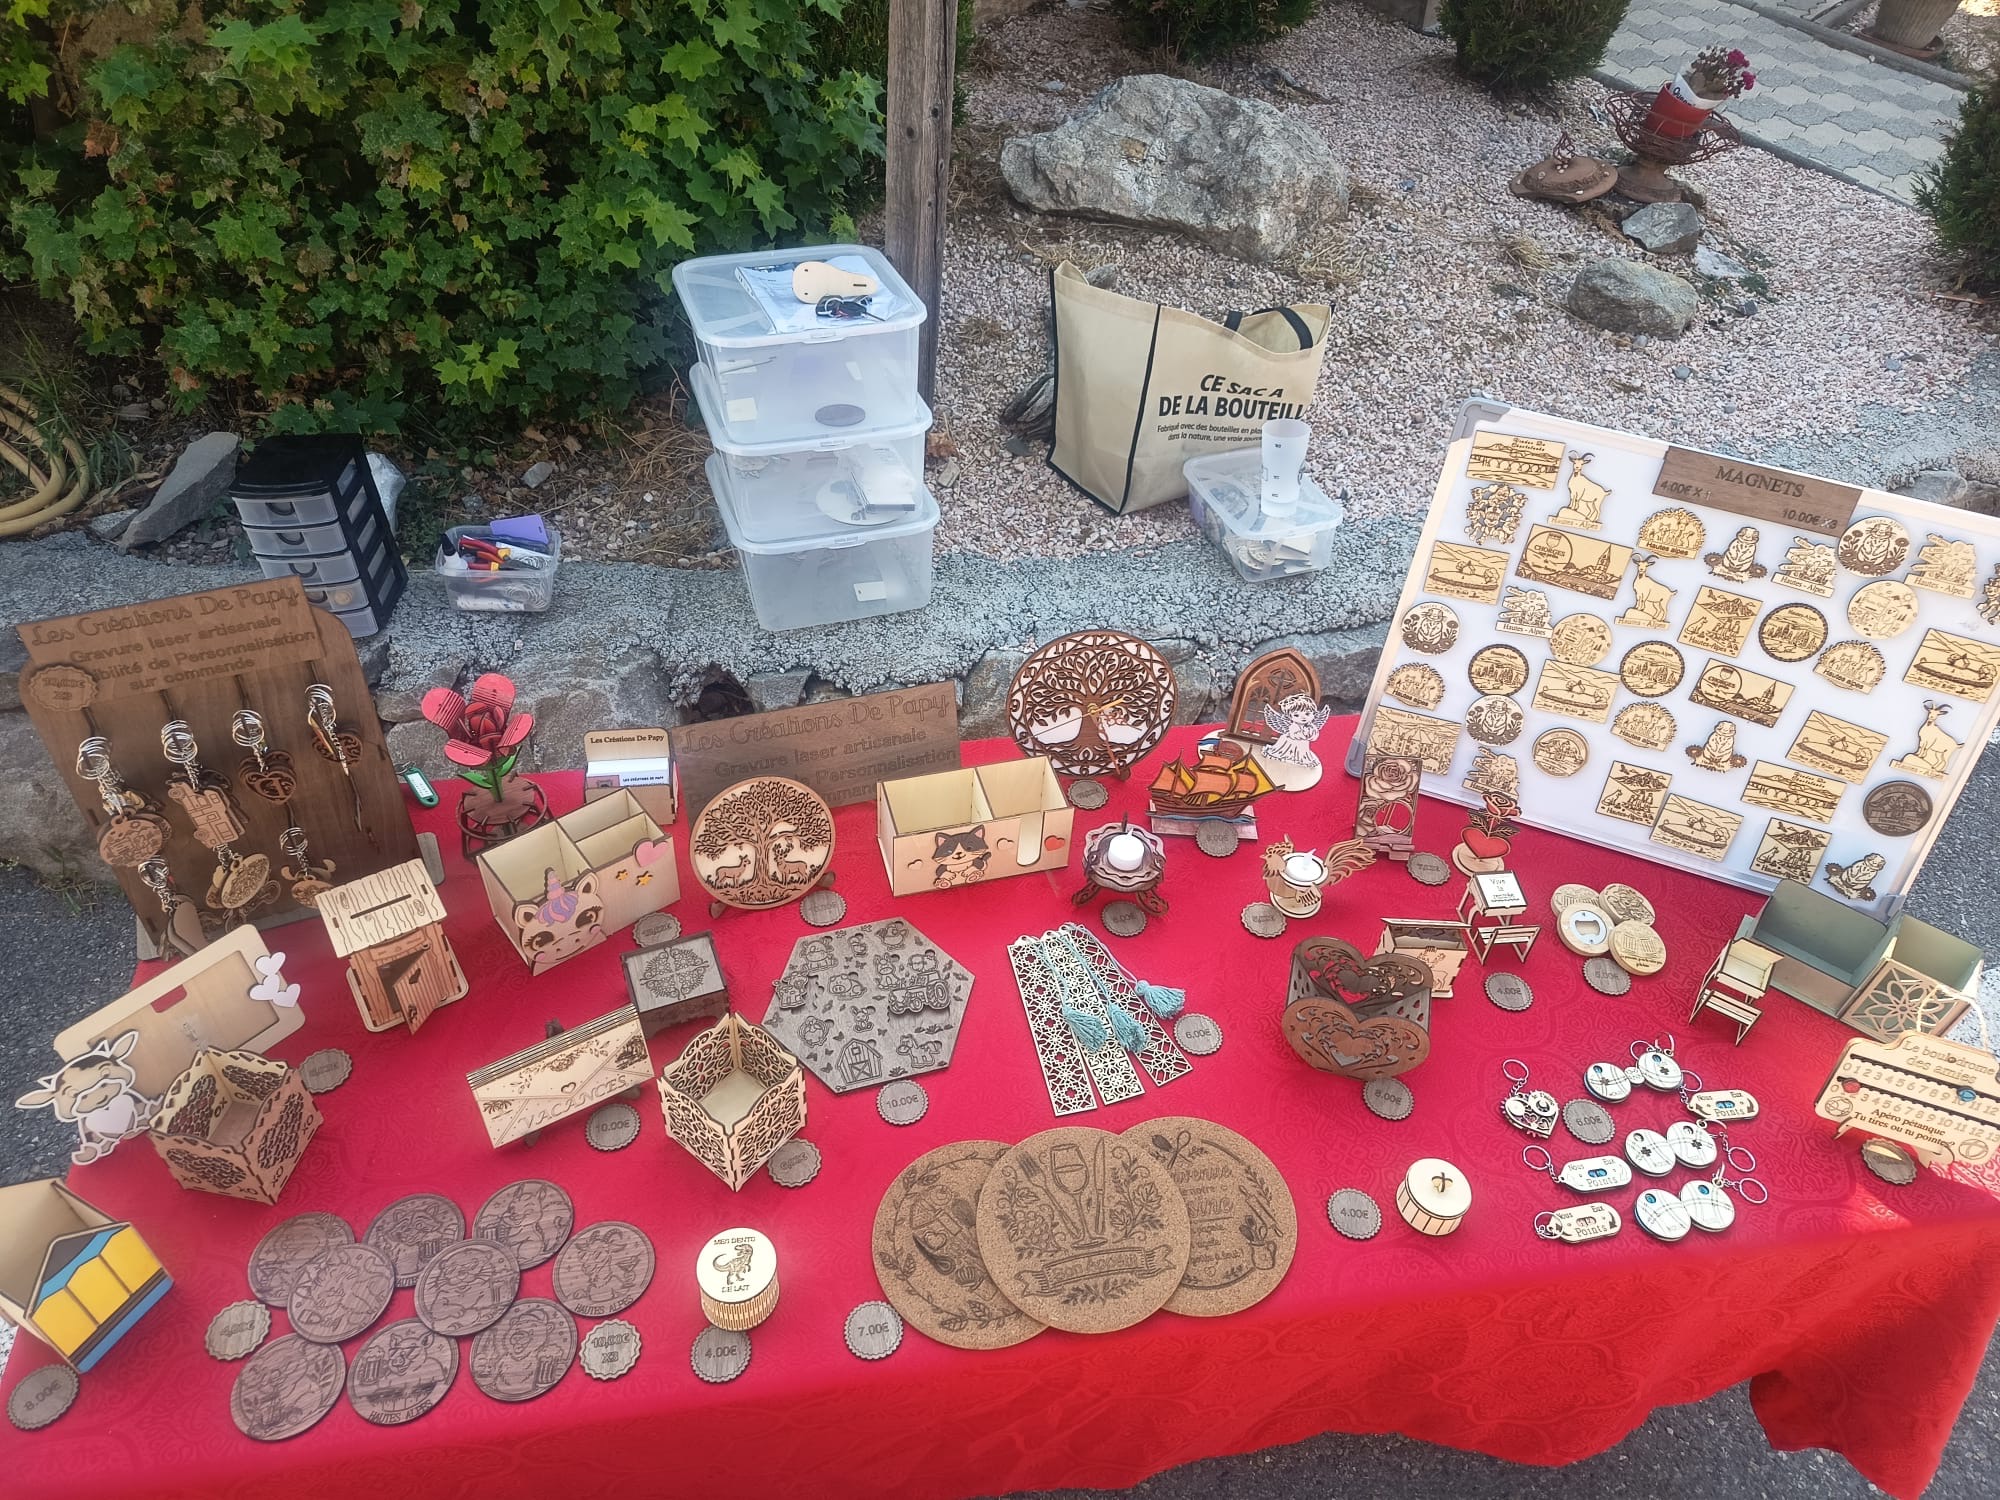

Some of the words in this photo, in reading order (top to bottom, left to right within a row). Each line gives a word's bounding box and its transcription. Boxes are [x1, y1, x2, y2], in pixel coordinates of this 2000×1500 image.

[1200, 374, 1226, 392] CE
[1227, 382, 1267, 397] SAC
[1269, 388, 1284, 398] A
[1159, 395, 1183, 417] DE
[1185, 395, 1208, 416] LA
[1214, 397, 1304, 421] BOUTEILL
[1157, 422, 1180, 433] Fabriqué
[1180, 423, 1195, 431] avec
[1196, 422, 1208, 431] des
[1209, 424, 1240, 435] bouteilles
[1181, 431, 1187, 440] la
[1214, 434, 1227, 442] une
[1660, 480, 1692, 496] 4.00€
[1715, 465, 1805, 498] MAGNETS
[1782, 508, 1819, 526] 10.00€
[1533, 544, 1567, 558] CHORGES
[1646, 543, 1669, 553] Hautes
[1780, 576, 1803, 587] Hautes
[1808, 584, 1826, 595] Alpes
[1914, 577, 1938, 588] Hautes
[1946, 584, 1966, 596] Alpes
[32, 624, 74, 647] Les
[77, 603, 192, 637] Créations
[195, 596, 234, 615] De
[232, 586, 298, 607] Papy
[70, 640, 143, 663] Gravure
[148, 632, 192, 650] laser
[199, 615, 281, 639] artisanale
[1503, 624, 1523, 632] Hautes
[1529, 627, 1547, 636] Alpes
[1054, 642, 1067, 655] 11
[1094, 635, 1110, 649] 12
[1135, 643, 1143, 657] 1
[98, 661, 143, 682] ibilité
[150, 656, 170, 671] de
[176, 630, 316, 665] Personnalisation
[130, 677, 155, 691] sur
[164, 658, 255, 684] commande
[1157, 667, 1168, 681] 2
[1823, 669, 1846, 683] Hautes
[1163, 699, 1172, 713] 3
[681, 729, 723, 755] Les
[730, 711, 842, 743] Créations
[849, 701, 883, 724] De
[889, 692, 950, 723] Papy
[590, 736, 603, 744] Les
[604, 735, 635, 744] Créations
[637, 734, 647, 742] De
[648, 734, 665, 742] Papy
[1619, 729, 1641, 742] Hautes
[1642, 737, 1659, 747] alpes
[714, 756, 788, 778] Gravure
[794, 748, 837, 763] laser
[843, 728, 927, 754] artisanale
[816, 749, 958, 786] Personnalisation
[1080, 765, 1089, 776] 6
[1903, 1040, 1920, 1053] Le
[1922, 1046, 1996, 1076] boulodrome
[1906, 1056, 1932, 1071] des
[1843, 1063, 1852, 1071] 0
[1853, 1066, 1861, 1074] 1
[1863, 1069, 1873, 1077] 2
[1874, 1072, 1883, 1080] 3
[1885, 1075, 1894, 1084] 4
[1896, 1079, 1905, 1087] 5
[1907, 1082, 1916, 1091] 6
[1918, 1085, 1929, 1094] 7
[1929, 1089, 1939, 1097] 8
[1941, 1092, 1951, 1101] 9
[1983, 1105, 1999, 1116] 12
[518, 1073, 628, 1129] VACANCES
[1714, 1108, 1745, 1118] Points
[1860, 1094, 1869, 1102] 3
[1872, 1097, 1880, 1106] 4
[1882, 1101, 1891, 1109] 5
[1893, 1104, 1902, 1112] 6
[1905, 1107, 1914, 1115] 7
[1915, 1111, 1925, 1119] 8
[1927, 1113, 1936, 1122] 9
[1937, 1117, 1953, 1128] 10
[1954, 1122, 1968, 1133] 11
[1969, 1127, 1985, 1138] 12
[1985, 1132, 2000, 1142] 13
[1871, 1108, 1901, 1123] Apéro
[1902, 1119, 1946, 1136] pétanque
[1853, 1111, 1867, 1121] Tu
[1868, 1116, 1888, 1128] tires
[1890, 1125, 1903, 1133] ou
[1904, 1127, 1914, 1136] tu
[1586, 1176, 1619, 1188] Points
[1340, 1207, 1369, 1220] 4.00€
[1575, 1225, 1608, 1237] Points
[575, 1303, 605, 1315] HAUTES
[609, 1296, 634, 1312] ALPES
[857, 1322, 890, 1338] 7.00€
[704, 1345, 738, 1359] 4.00€
[369, 1410, 401, 1425] HAUTES
[405, 1399, 433, 1419] ALPES
